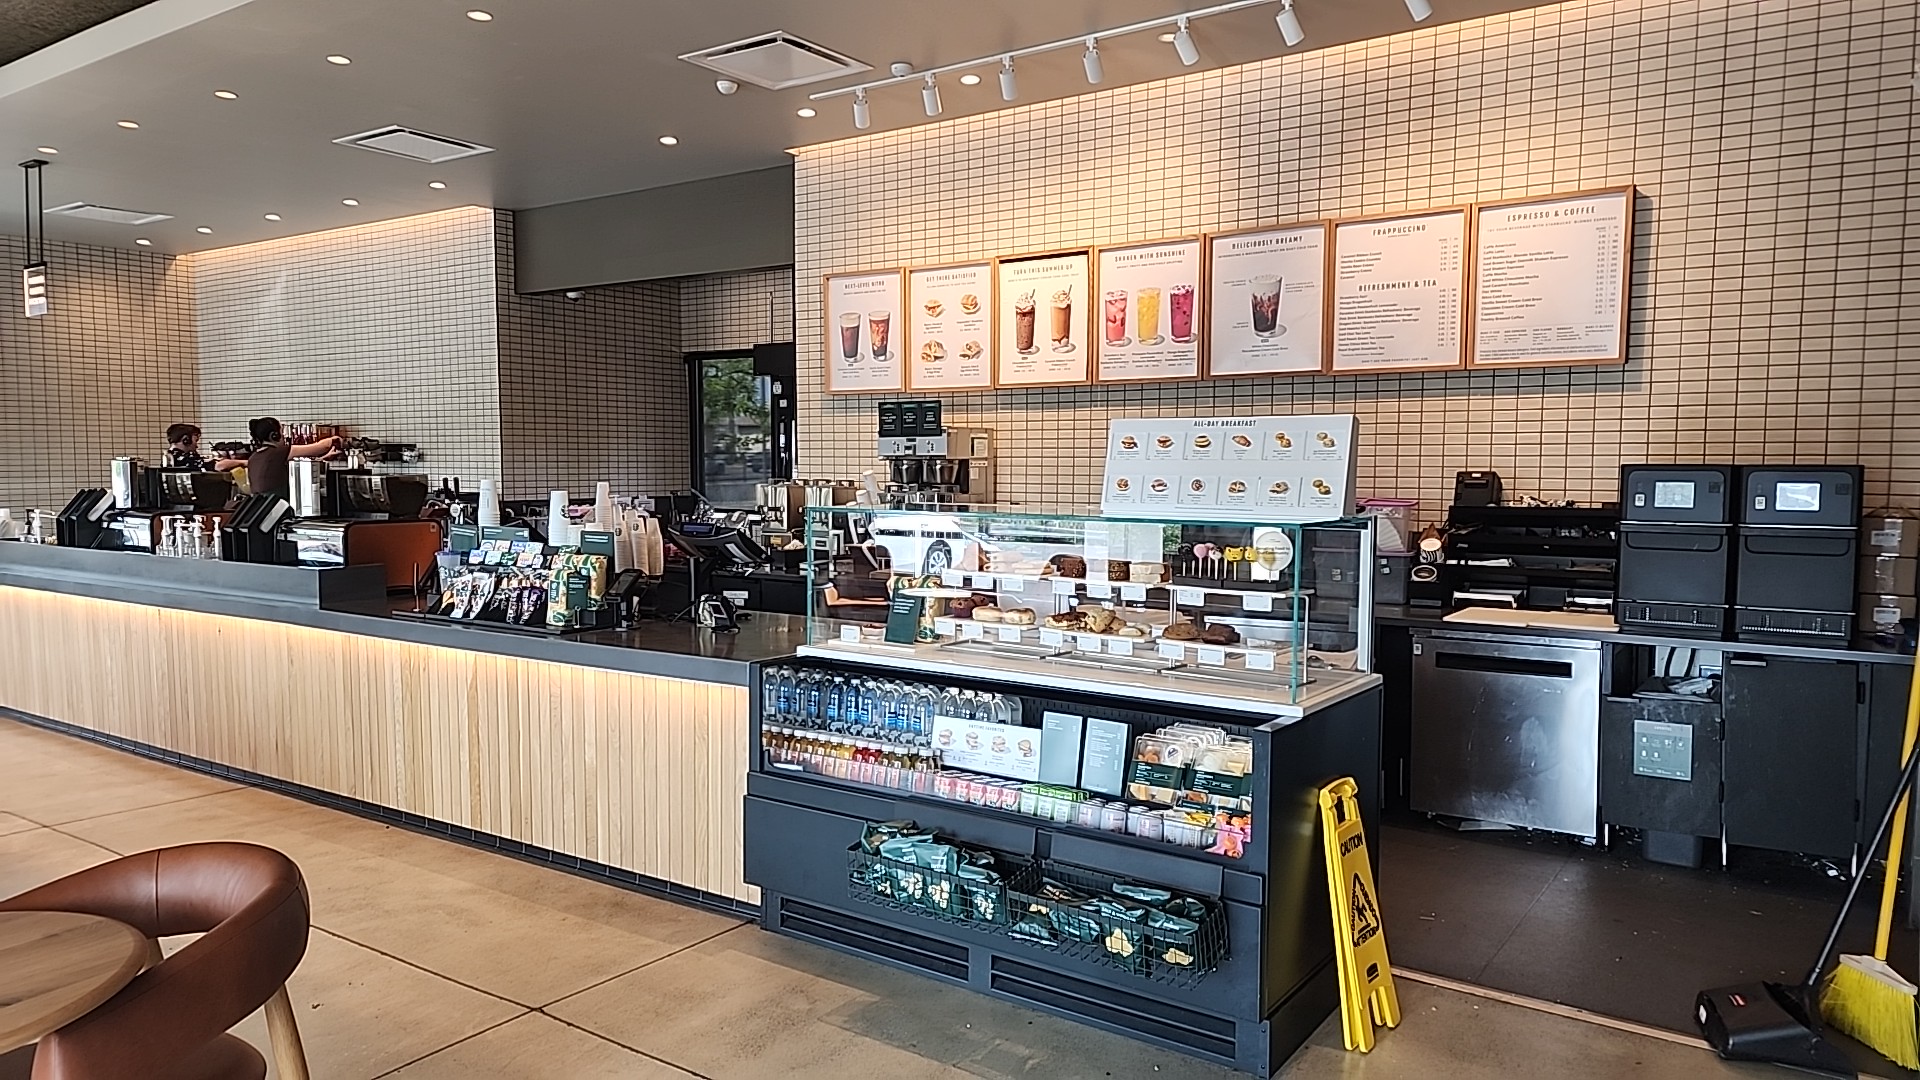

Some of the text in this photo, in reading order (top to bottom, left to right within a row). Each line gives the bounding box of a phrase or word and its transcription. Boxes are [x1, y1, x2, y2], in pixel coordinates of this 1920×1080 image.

[1507, 211, 1550, 222] ESPRESSO
[1564, 206, 1595, 216] COFFEE
[1232, 236, 1303, 249] DELICIOUSLY DREAMY
[1156, 249, 1186, 258] SUNSHINE
[1359, 281, 1411, 292] REFRESHMENT
[1340, 832, 1363, 857] CAUTION
